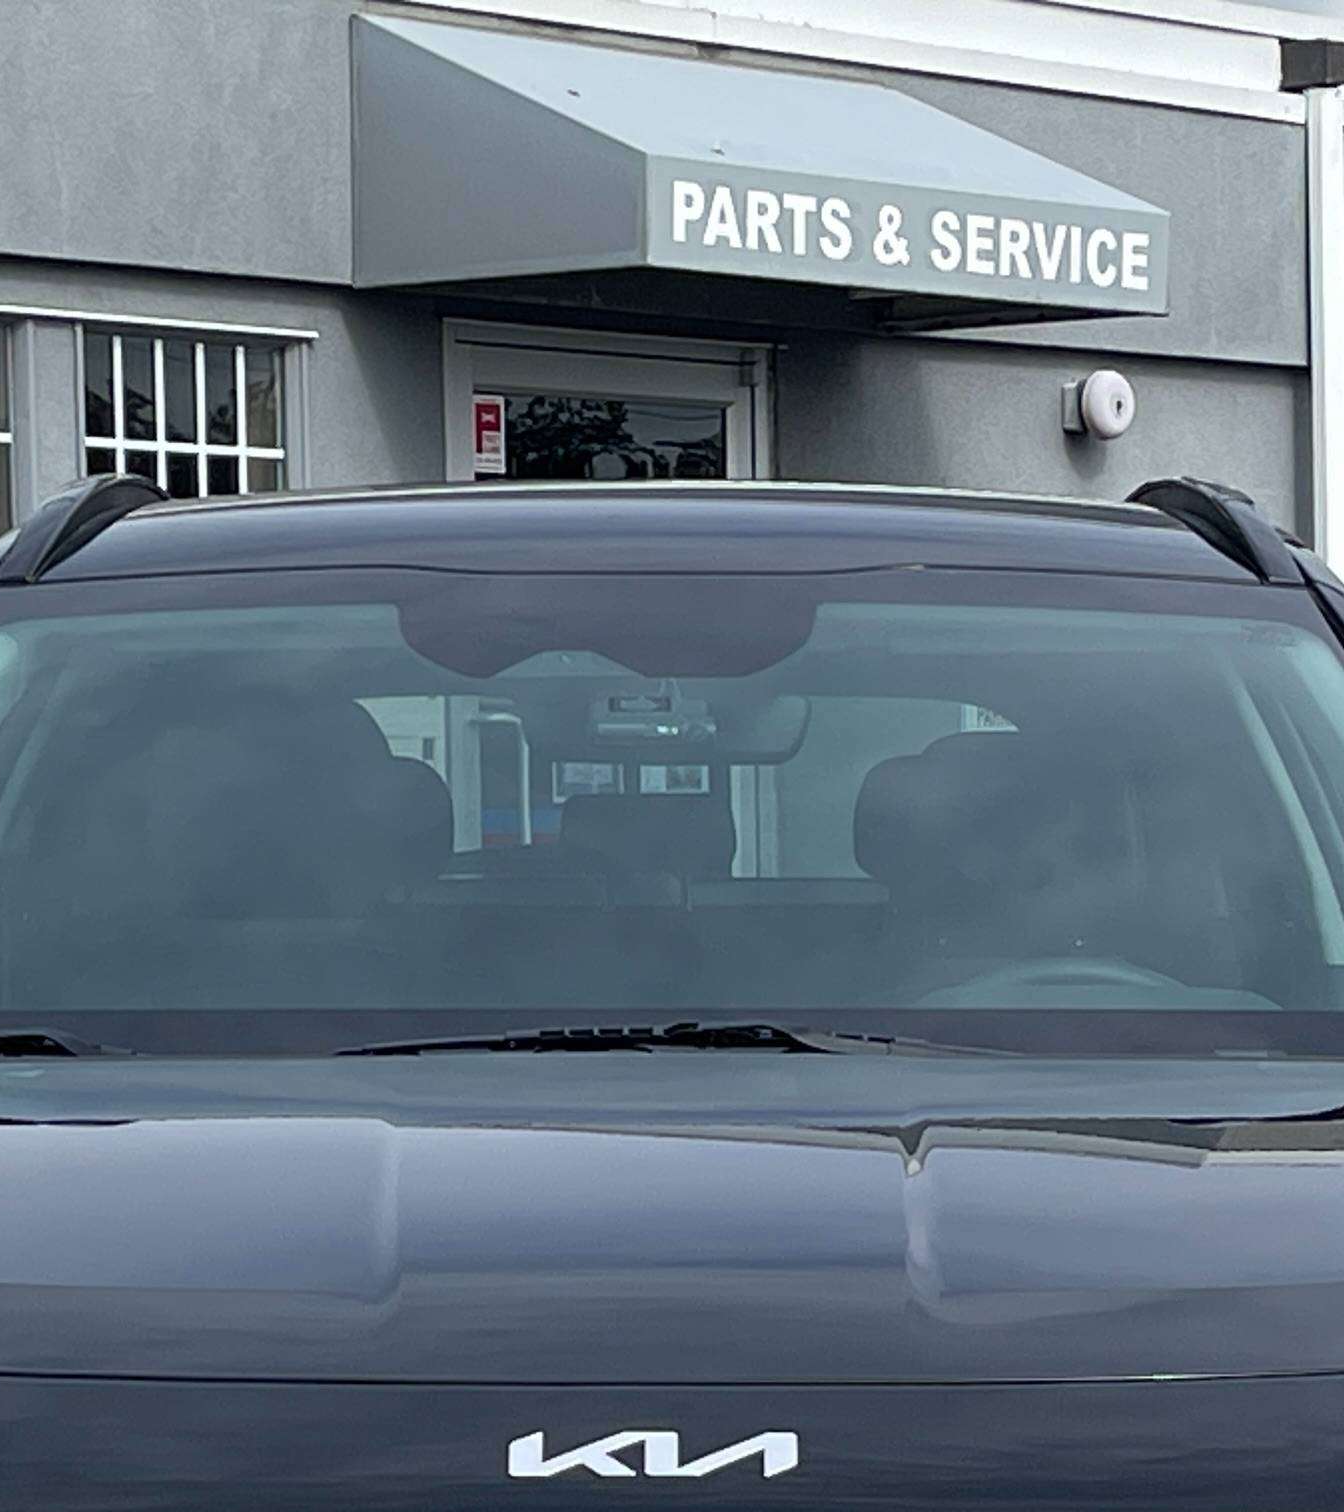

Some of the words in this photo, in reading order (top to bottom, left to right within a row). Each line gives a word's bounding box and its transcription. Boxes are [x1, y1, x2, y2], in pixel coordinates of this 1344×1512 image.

[671, 179, 853, 260] PARTS
[873, 204, 910, 267] &
[930, 209, 1150, 292] SERVICE
[508, 1431, 798, 1478] KIA
